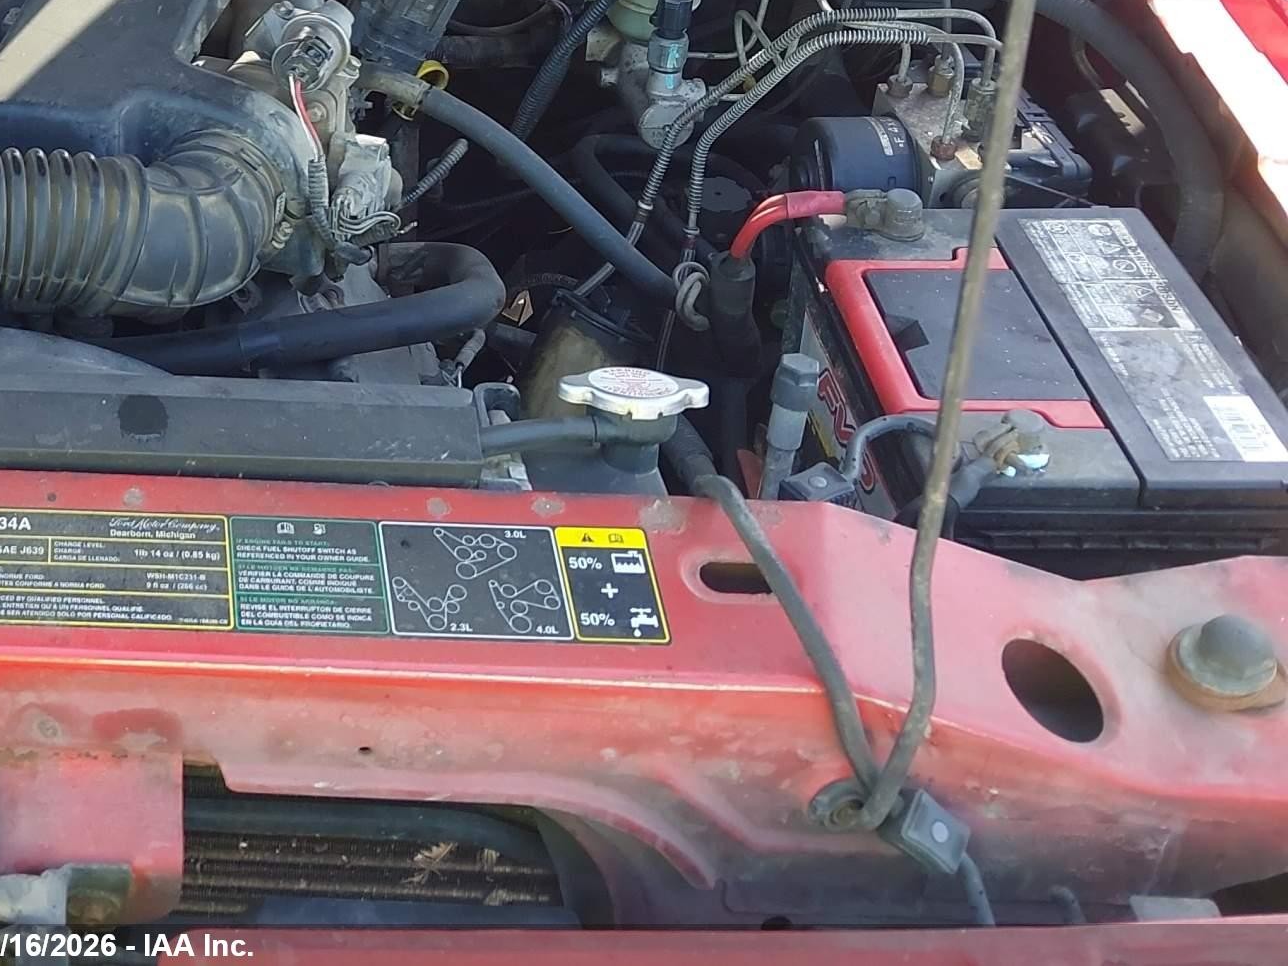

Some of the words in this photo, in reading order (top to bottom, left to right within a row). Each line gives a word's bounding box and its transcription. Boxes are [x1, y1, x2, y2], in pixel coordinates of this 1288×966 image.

[110, 529, 153, 538] Dearborn,
[155, 530, 196, 540] Michigan
[504, 530, 526, 539] 3.0L
[19, 545, 44, 555] J639
[150, 550, 161, 558] 14
[180, 551, 203, 559] (0.85
[205, 551, 220, 561] kg)
[236, 551, 285, 559] REFERENCED
[568, 556, 603, 570] 50%
[282, 571, 325, 579] COMMANDE
[239, 602, 266, 610] REVISE
[256, 611, 309, 619] COMBUSTIBLE
[580, 612, 616, 627] 50%
[450, 623, 473, 632] 2.3L
[536, 625, 559, 634] 4.0L
